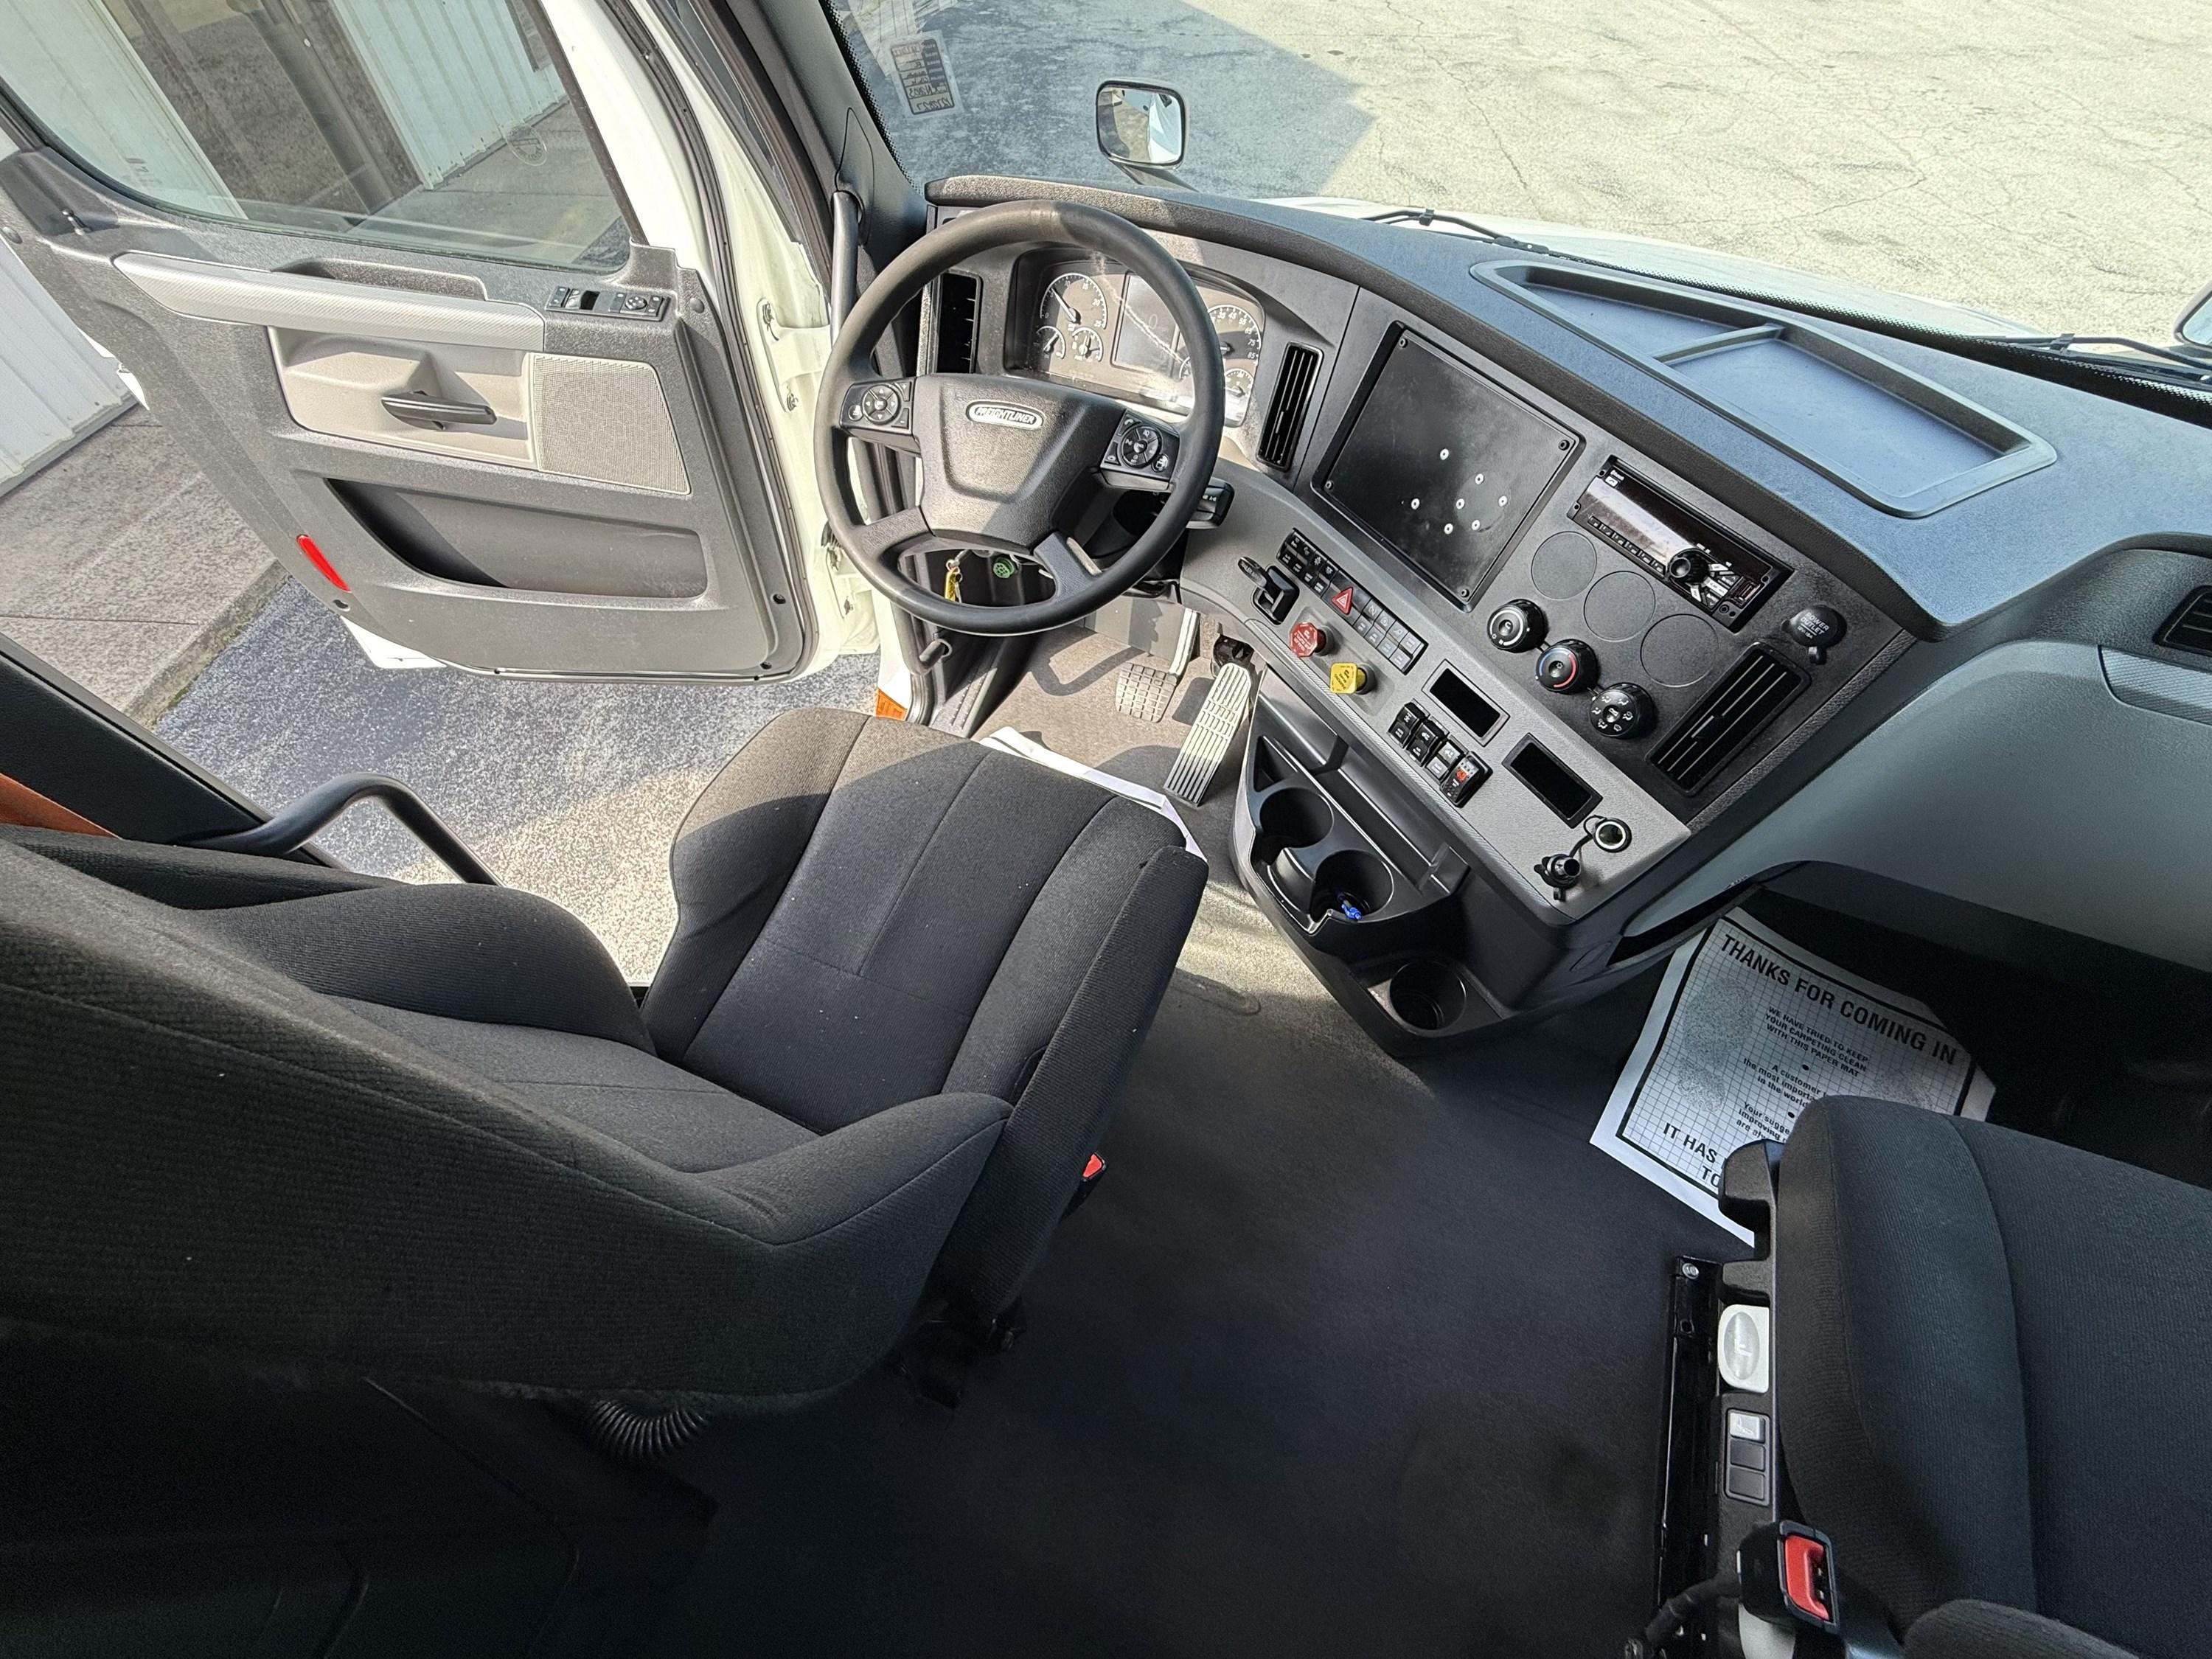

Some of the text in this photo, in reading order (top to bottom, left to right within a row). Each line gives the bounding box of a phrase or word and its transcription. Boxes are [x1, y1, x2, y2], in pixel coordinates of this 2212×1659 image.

[1092, 298, 1101, 307] 20
[974, 407, 1037, 425] FREIGHTLINER
[1800, 616, 1825, 635] OUTLET
[1805, 612, 1830, 631] POWER
[1722, 933, 1958, 1065] THANKS FOR COMING IN
[1765, 1014, 1867, 1071] YOUR CARPETING CLEAN
[1768, 1006, 1868, 1062] WE HAVE TRIED TO KEEP
[1767, 1023, 1860, 1077] WITH THIS PAPER MAT
[1743, 1057, 1756, 1069] the
[1759, 1067, 1780, 1083] most
[1772, 1064, 1821, 1096] A customer
[1757, 1075, 1766, 1085] in
[1767, 1081, 1781, 1093] the
[1744, 1102, 1763, 1118] Your
[1736, 1119, 1751, 1133] are
[1738, 1108, 1781, 1141] improving
[1663, 1122, 1681, 1139] IT
[1683, 1134, 1717, 1164] HAS
